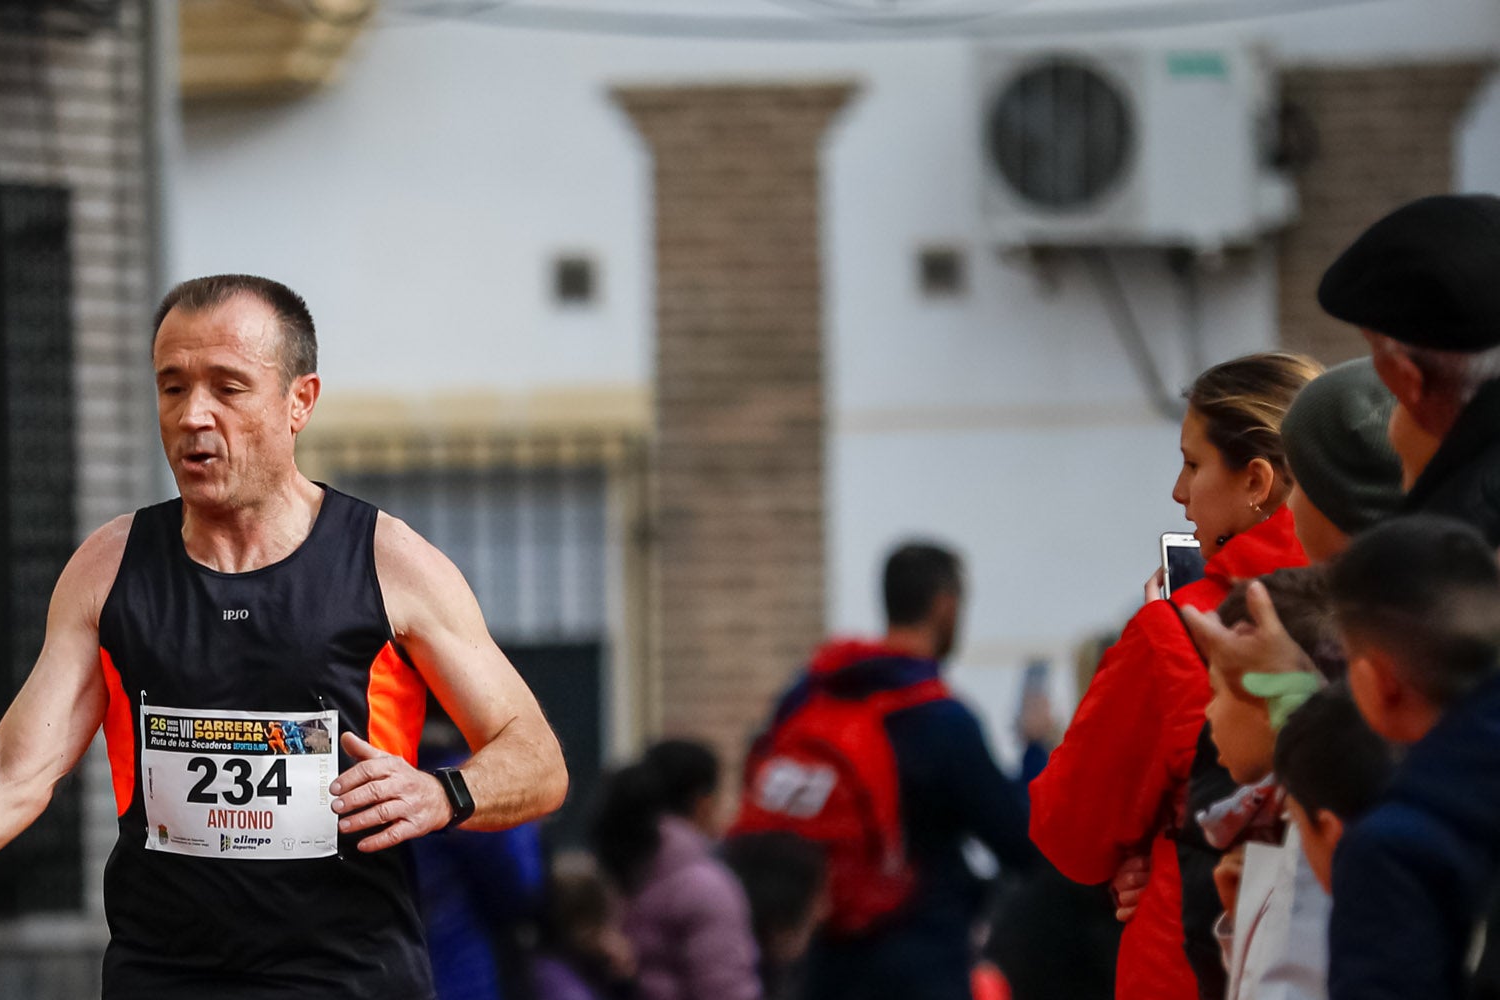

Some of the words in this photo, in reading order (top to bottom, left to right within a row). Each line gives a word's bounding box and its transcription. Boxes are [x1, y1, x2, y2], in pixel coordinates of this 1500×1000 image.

[150, 717, 167, 731] 26
[180, 719, 194, 739] VII
[193, 720, 264, 733] CARRERA
[151, 737, 167, 746] Ruta
[168, 739, 177, 747] de
[178, 739, 190, 748] los
[191, 740, 232, 750] Secaderos
[194, 731, 264, 742] POPULAR
[186, 756, 292, 806] 234
[207, 809, 274, 830] ANTONIO
[233, 835, 271, 846] olimpo
